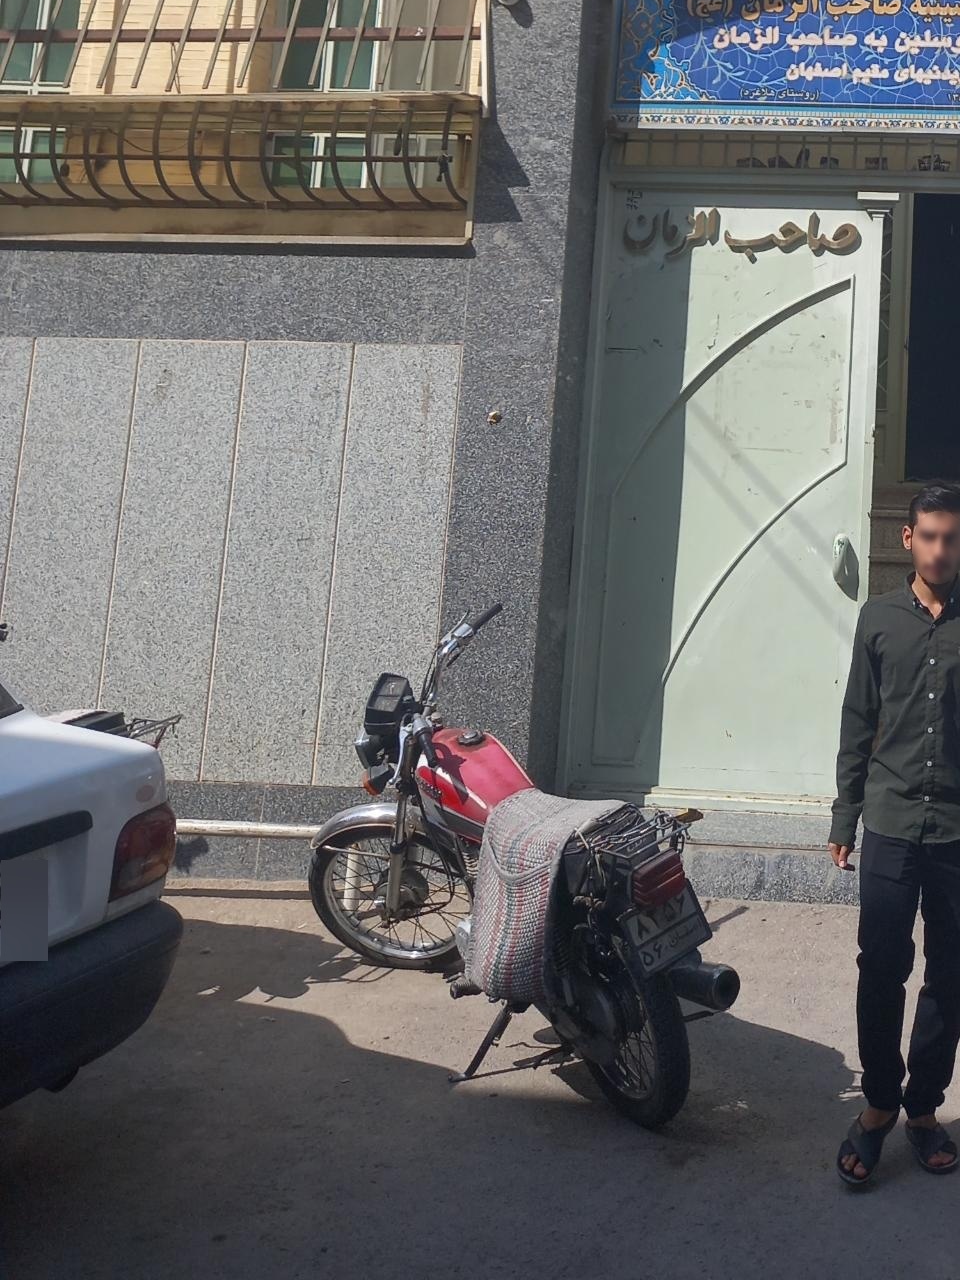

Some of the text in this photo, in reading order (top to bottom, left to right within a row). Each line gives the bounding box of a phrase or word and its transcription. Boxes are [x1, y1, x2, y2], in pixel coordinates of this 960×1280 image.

[712, 25, 780, 51] الزمان
[785, 25, 858, 52] صاحب
[863, 31, 889, 53] به
[785, 61, 848, 82] اصفهان
[852, 63, 890, 86] مقیم
[622, 207, 862, 264] صاحب الزمان
